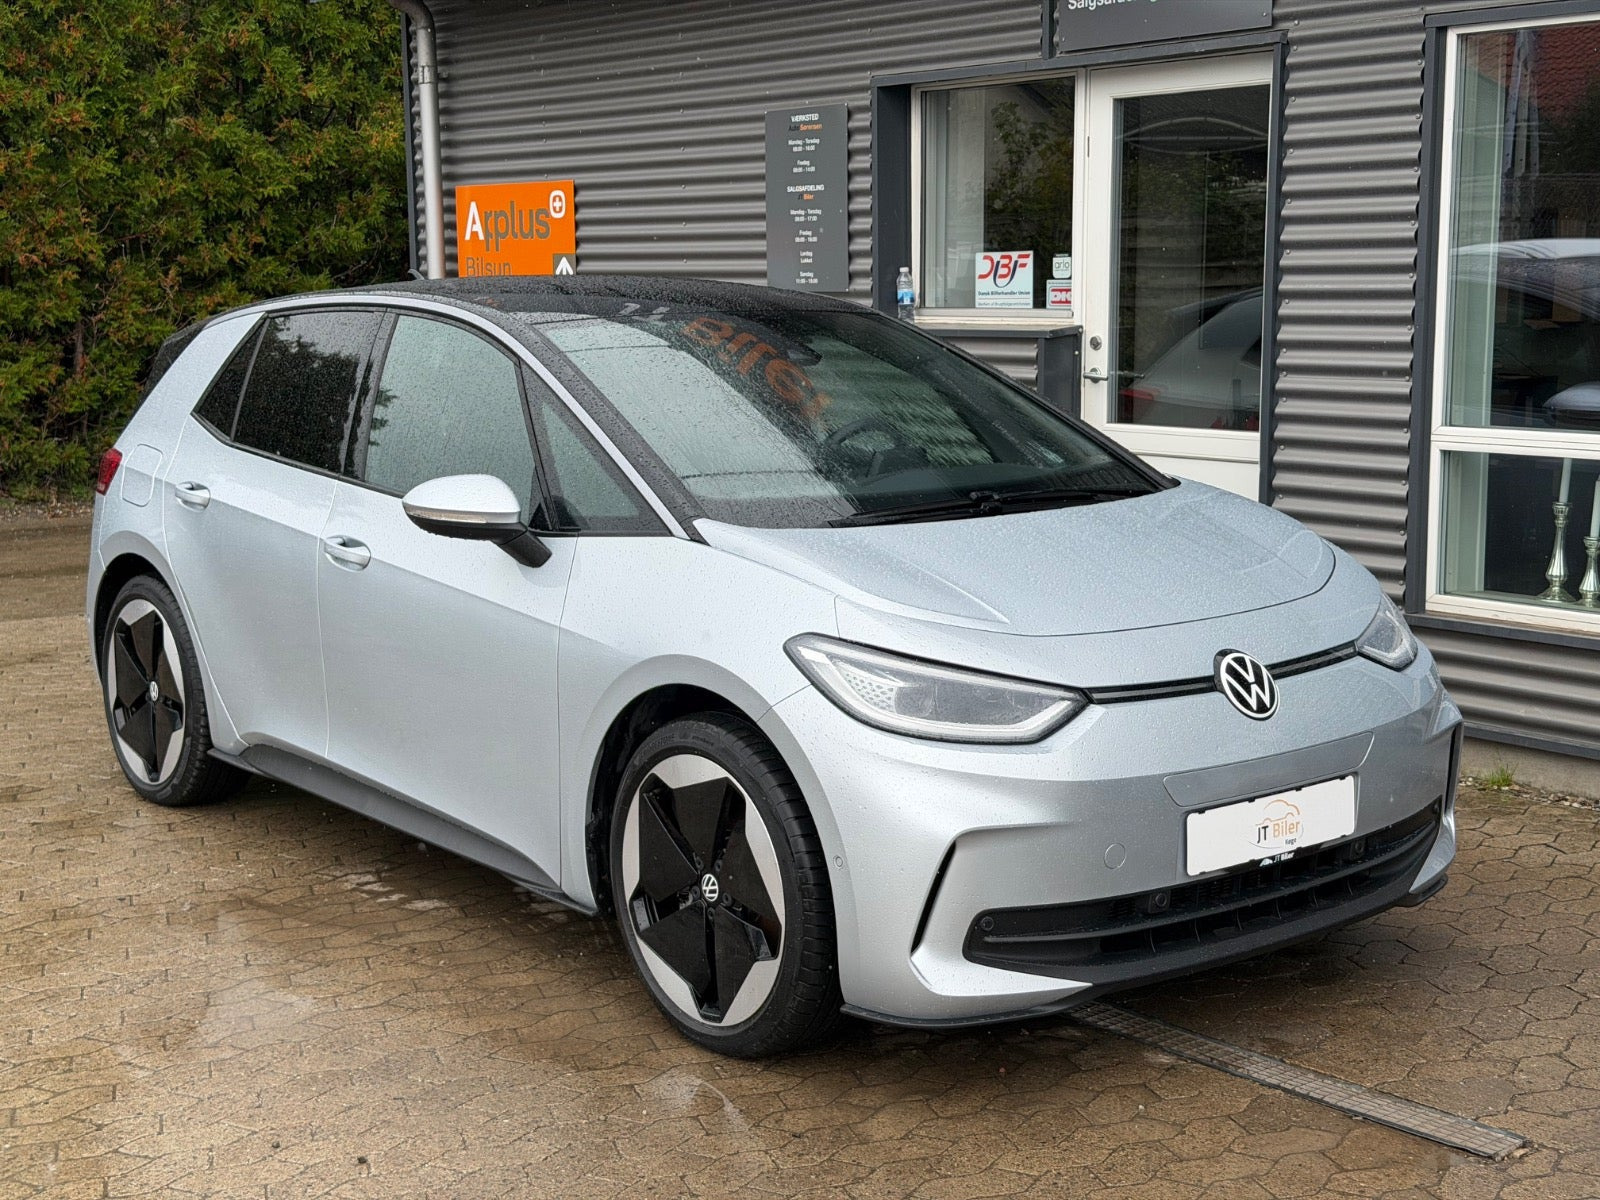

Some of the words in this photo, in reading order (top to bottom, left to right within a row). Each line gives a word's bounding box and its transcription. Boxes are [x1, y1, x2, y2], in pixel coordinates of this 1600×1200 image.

[787, 184, 825, 193] SALGSAFDELING
[1257, 825, 1269, 844] JT
[1272, 820, 1300, 838] Biler
